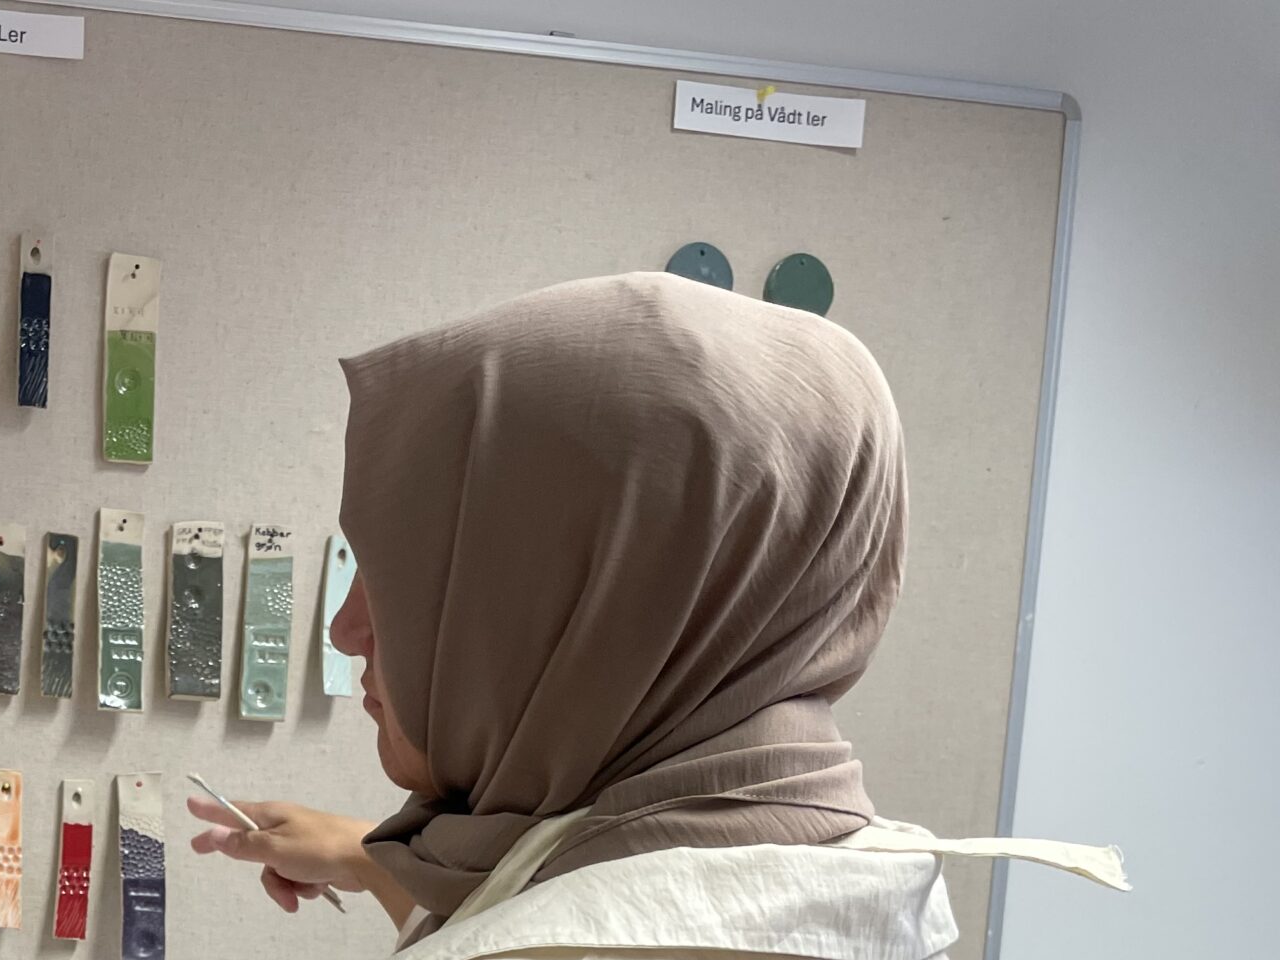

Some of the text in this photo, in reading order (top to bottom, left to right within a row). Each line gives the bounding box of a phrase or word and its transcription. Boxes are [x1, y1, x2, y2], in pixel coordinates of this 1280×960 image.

[690, 97, 827, 127] Maling på Vådt ler
